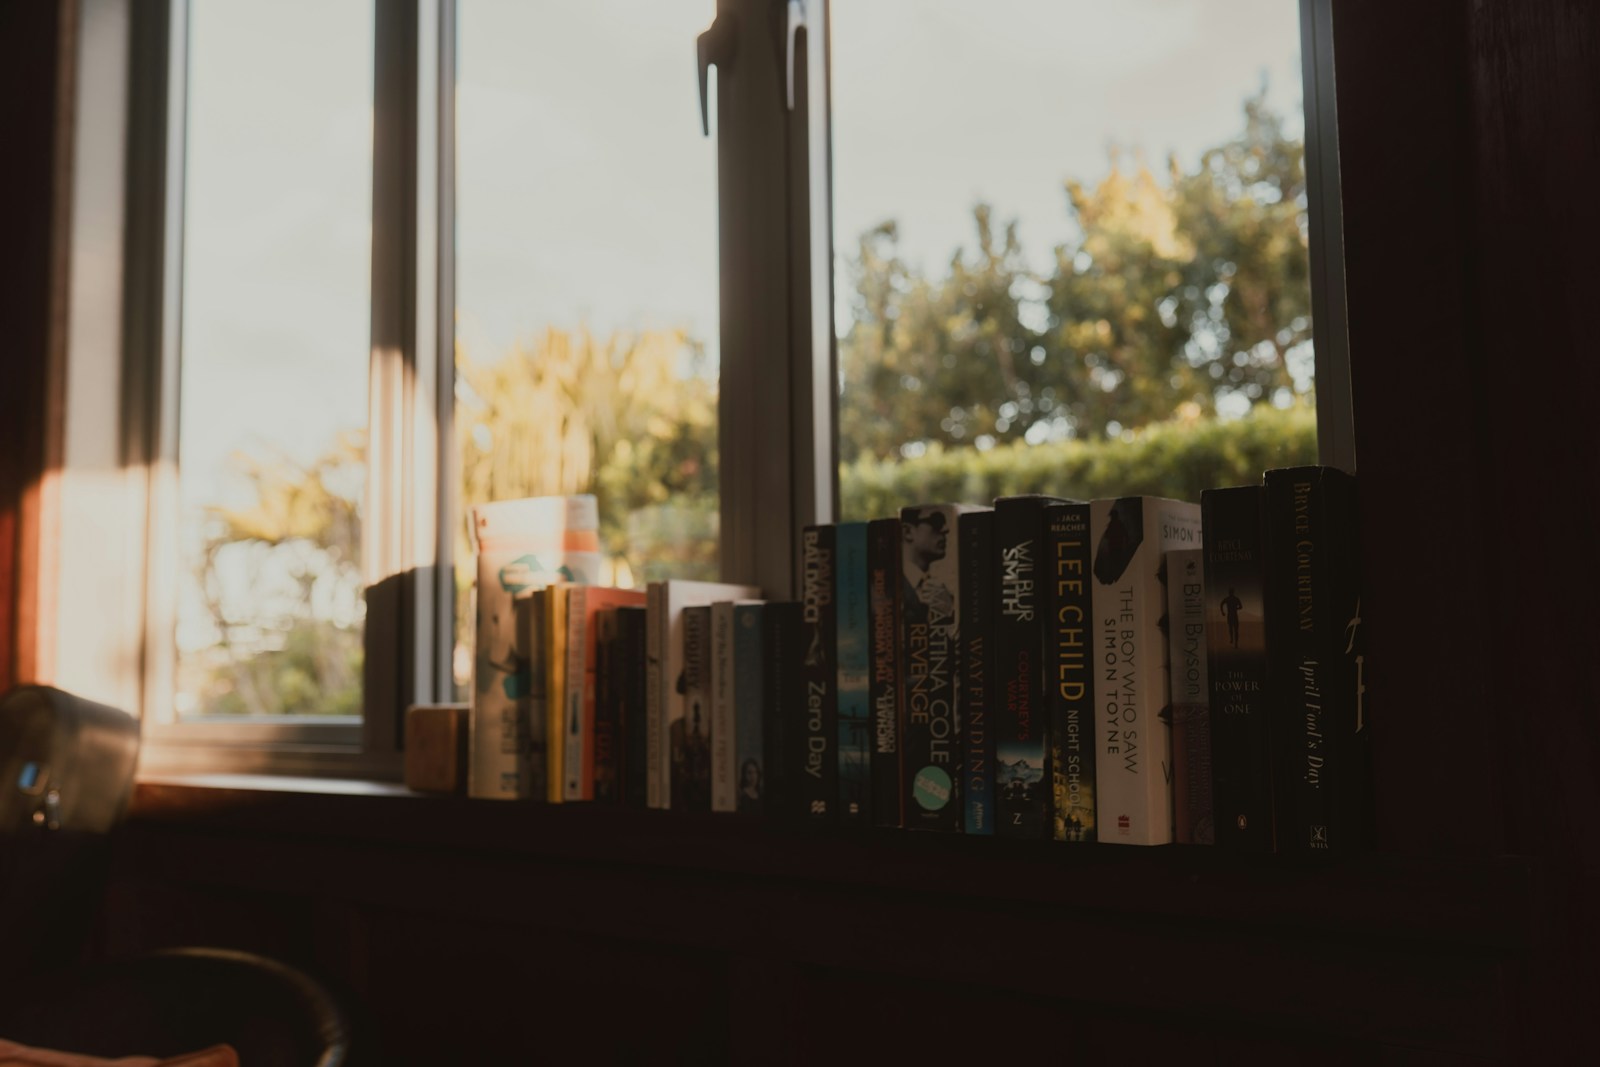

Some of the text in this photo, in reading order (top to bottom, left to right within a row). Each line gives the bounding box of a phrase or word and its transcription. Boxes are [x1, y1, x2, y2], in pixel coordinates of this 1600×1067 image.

[1051, 523, 1086, 532] REACHER
[1062, 514, 1081, 522] JACK
[1163, 524, 1194, 542] SIMON
[803, 530, 820, 624] BALDACCI
[817, 548, 832, 607] DAVID
[1001, 547, 1019, 616] SMITH
[1015, 539, 1035, 622] WILBUR
[1056, 541, 1084, 597] LEE
[875, 656, 886, 684] THE
[927, 583, 949, 693] MARTINA
[1058, 604, 1086, 702] CHILD
[1183, 582, 1204, 697] Bill Bryson
[1293, 481, 1326, 790] BRYCE COURTENAY April Fool's Day
[910, 623, 929, 724] REVENGE
[1007, 679, 1018, 712] WAR
[1018, 649, 1031, 742] COURTNEY'S
[1104, 618, 1120, 756] SIMON TOYNE
[1119, 585, 1139, 775] THE BOY WHO SAW
[1215, 680, 1261, 692] POWER
[1227, 671, 1244, 680] THE
[804, 680, 827, 779] Zero Day
[876, 696, 888, 754] MICHAEL
[886, 684, 896, 754] CONNELLY
[929, 699, 950, 763] COLE
[967, 635, 986, 793] WAYFINDING
[1199, 720, 1209, 752] Short
[1224, 703, 1252, 714] ONE
[1067, 709, 1081, 810] NIGHT SCHOOL
